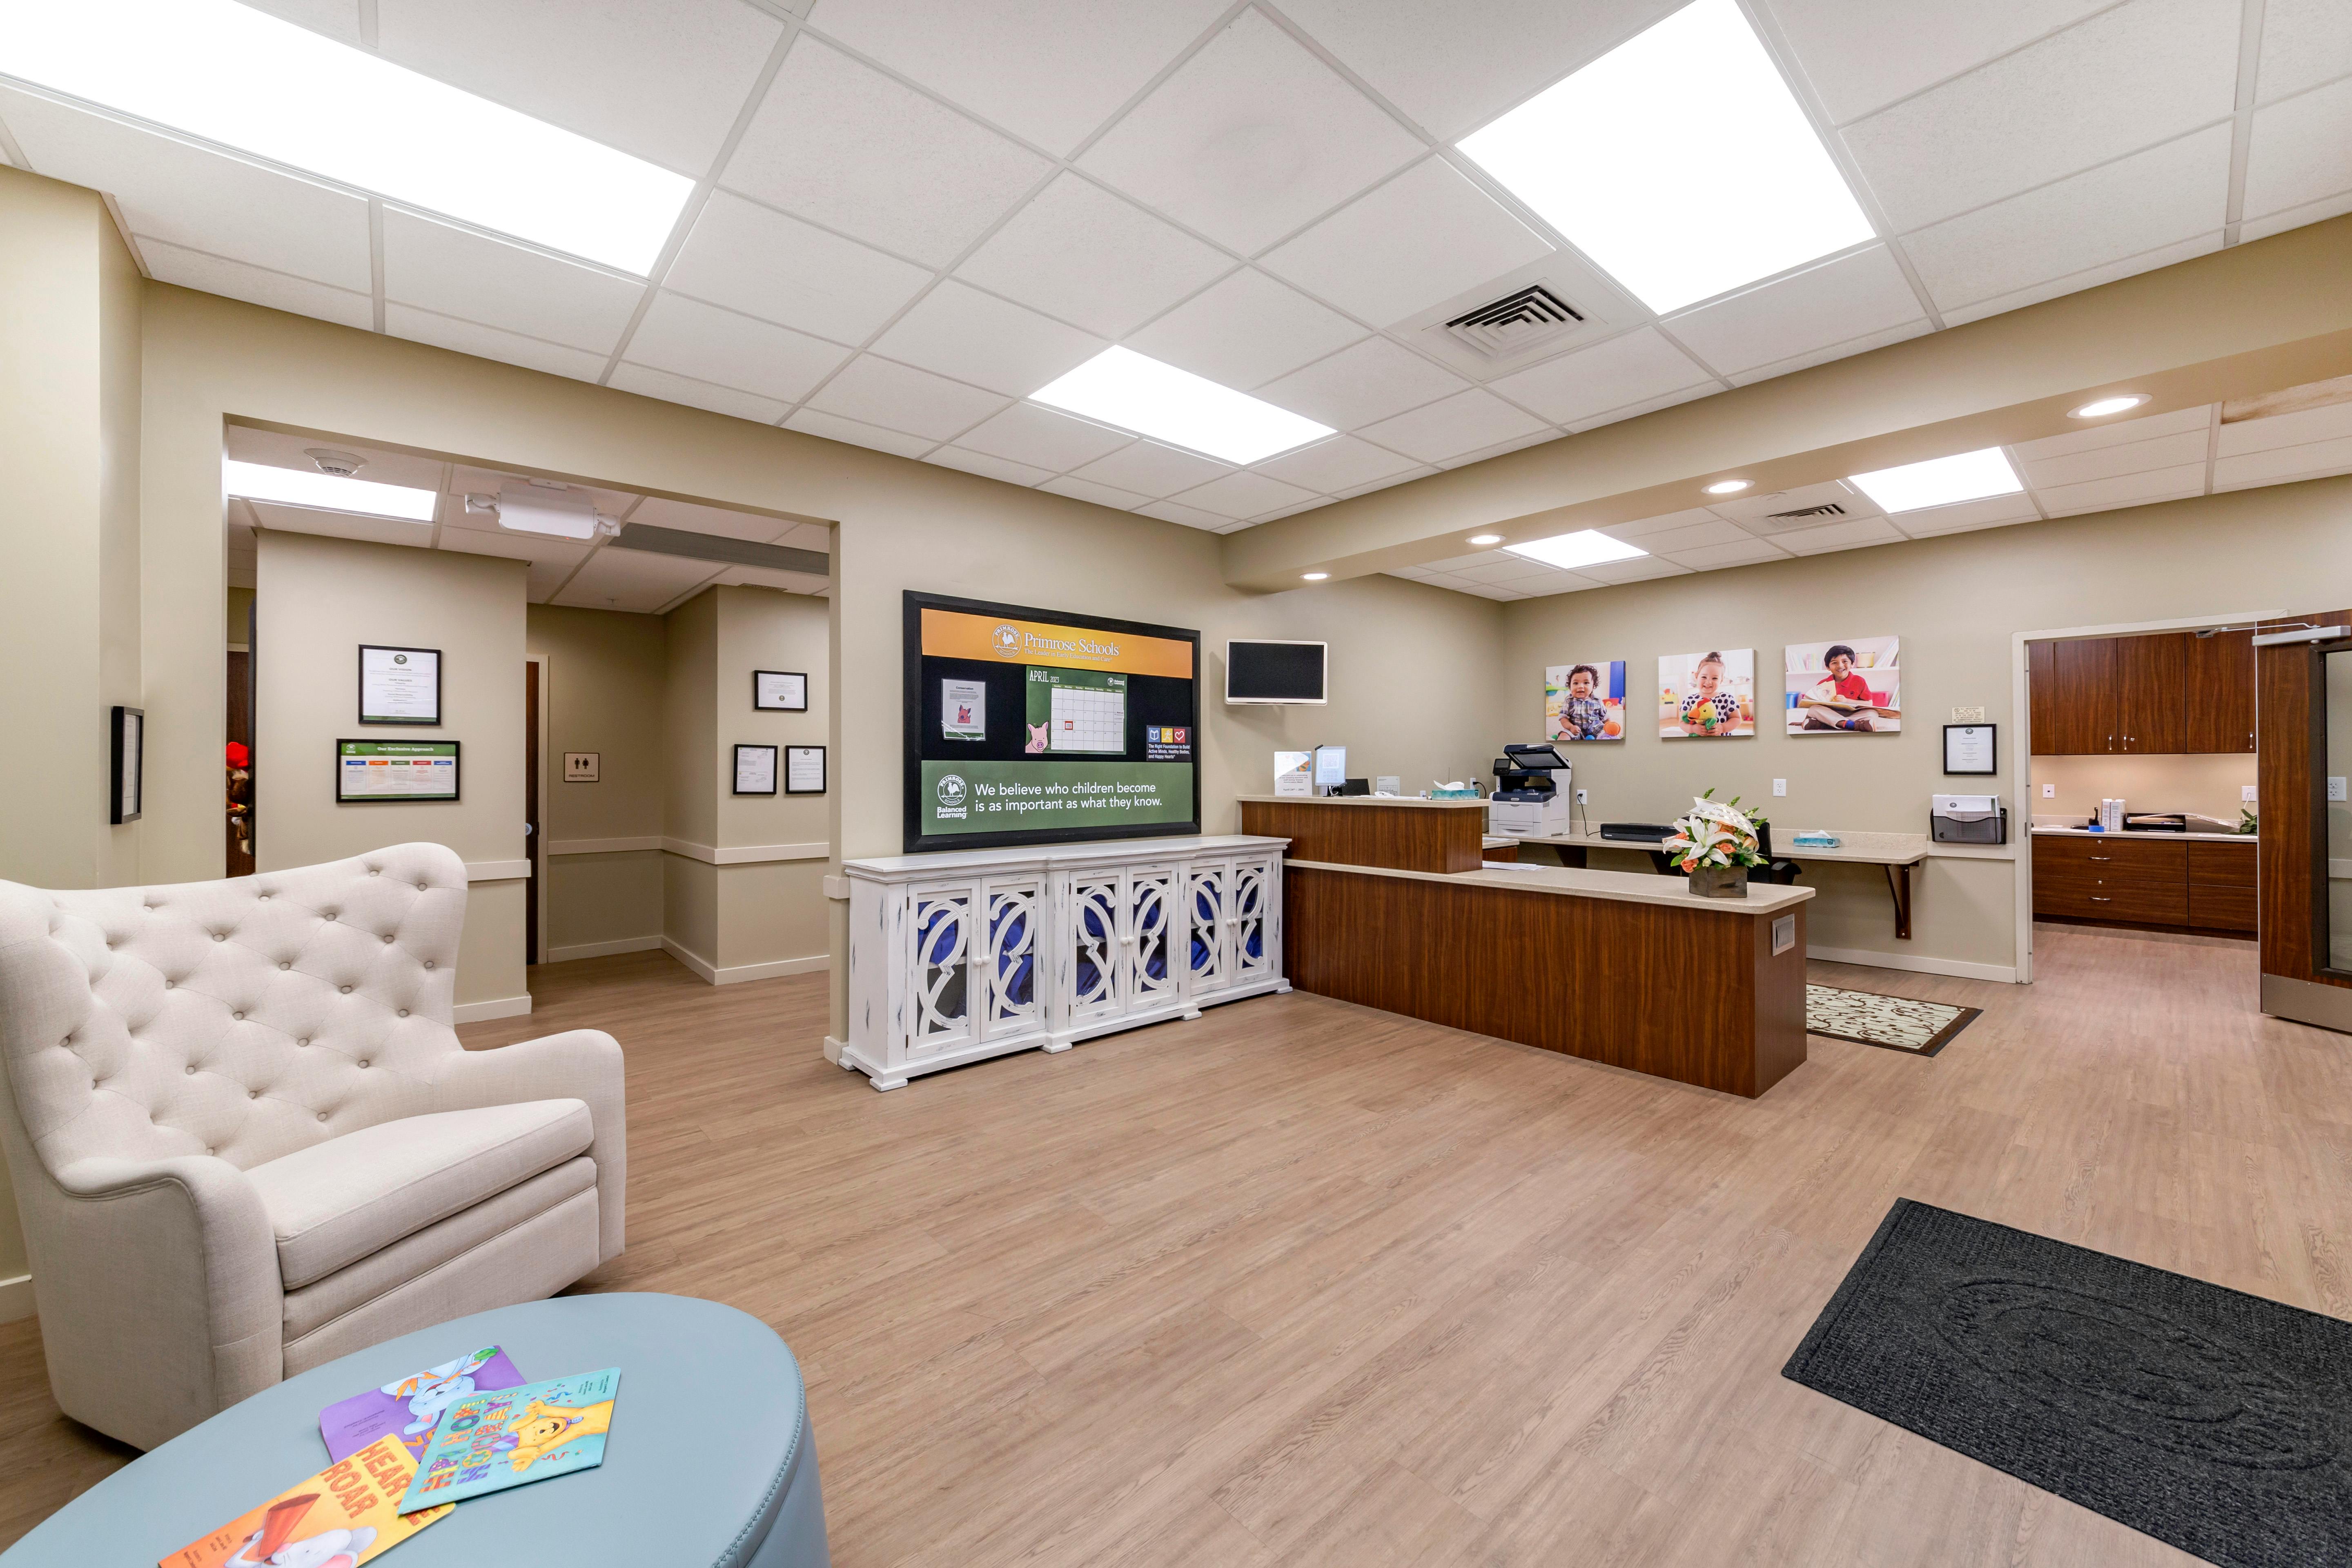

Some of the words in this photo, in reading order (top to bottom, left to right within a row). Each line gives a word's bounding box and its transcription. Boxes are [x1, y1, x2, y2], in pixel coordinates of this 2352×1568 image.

[995, 626, 1019, 637] PRIMROSE
[1025, 633, 1076, 651] Primrose
[1079, 639, 1119, 656] Schools
[1029, 670, 1049, 682] APRIL
[940, 776, 964, 787] PRIMROSE
[975, 783, 995, 795] We
[1000, 783, 1042, 795] believe
[1045, 782, 1069, 794] who
[1072, 782, 1114, 794] children
[1117, 782, 1156, 793] become
[976, 800, 984, 811] is
[989, 802, 1002, 811] as
[1006, 799, 1062, 814] important
[1066, 800, 1077, 809] as
[1081, 796, 1106, 808] what
[1109, 795, 1131, 810] they
[1134, 795, 1162, 806] know.
[441, 1399, 487, 1448] HOP!
[457, 1392, 518, 1485] HOORAY!
[356, 1441, 416, 1498] HEAR
[419, 1448, 468, 1494] HIP!
[320, 1460, 379, 1519] ROAR
